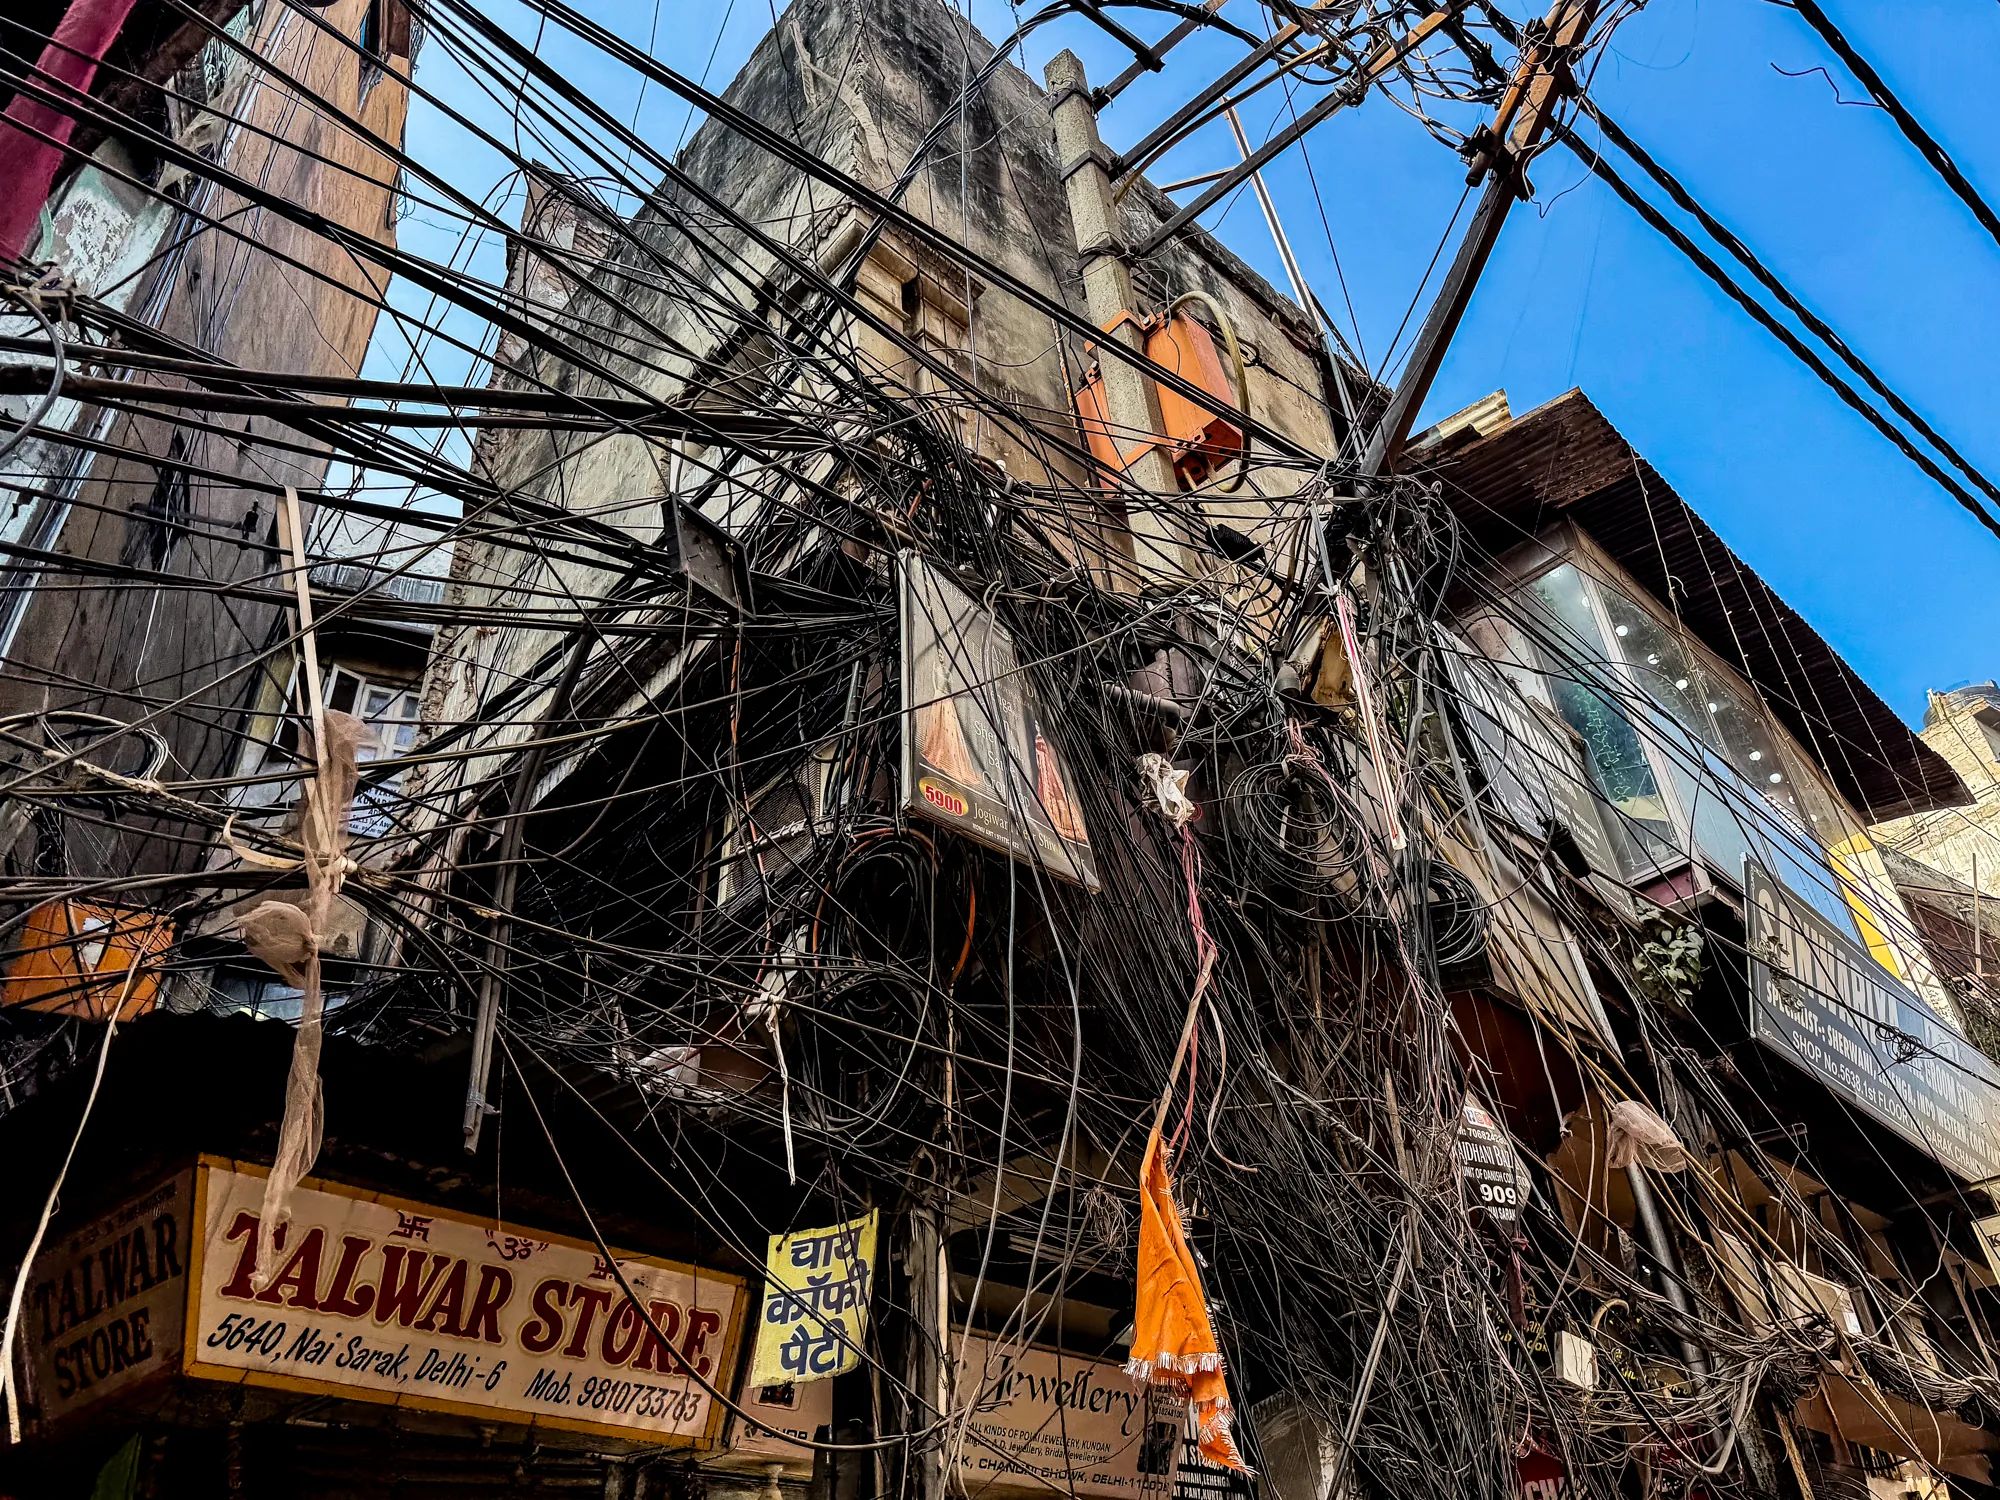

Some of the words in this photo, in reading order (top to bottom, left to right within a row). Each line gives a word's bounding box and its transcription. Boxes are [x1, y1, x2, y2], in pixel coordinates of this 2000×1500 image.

[925, 784, 963, 816] 5900
[1827, 1024, 1877, 1081] SHERWANI,
[1792, 1030, 1822, 1063] SHOP
[1878, 1090, 1909, 1127] FLOOR
[1925, 1125, 1954, 1157] SARAK
[1925, 1058, 1957, 1108] GROOM
[1458, 1141, 1495, 1166] AJDHANI
[1480, 1184, 1516, 1206] 909
[791, 1224, 866, 1269] चाय
[35, 1212, 182, 1344] TALWAR
[219, 1211, 514, 1344] TALWAR
[519, 1277, 721, 1378] STORE
[54, 1307, 152, 1399] STORE
[284, 1326, 342, 1365] Nai
[336, 1335, 410, 1384] Sarak,
[415, 1349, 508, 1391] Delhi-6
[524, 1368, 572, 1406] Mob.
[576, 1376, 703, 1422] 9810733763
[983, 1424, 1007, 1437] KINDS
[1008, 1428, 1019, 1439] OF
[1041, 1434, 1080, 1450] JEWELERY,
[1081, 1440, 1111, 1453] KUNDAN
